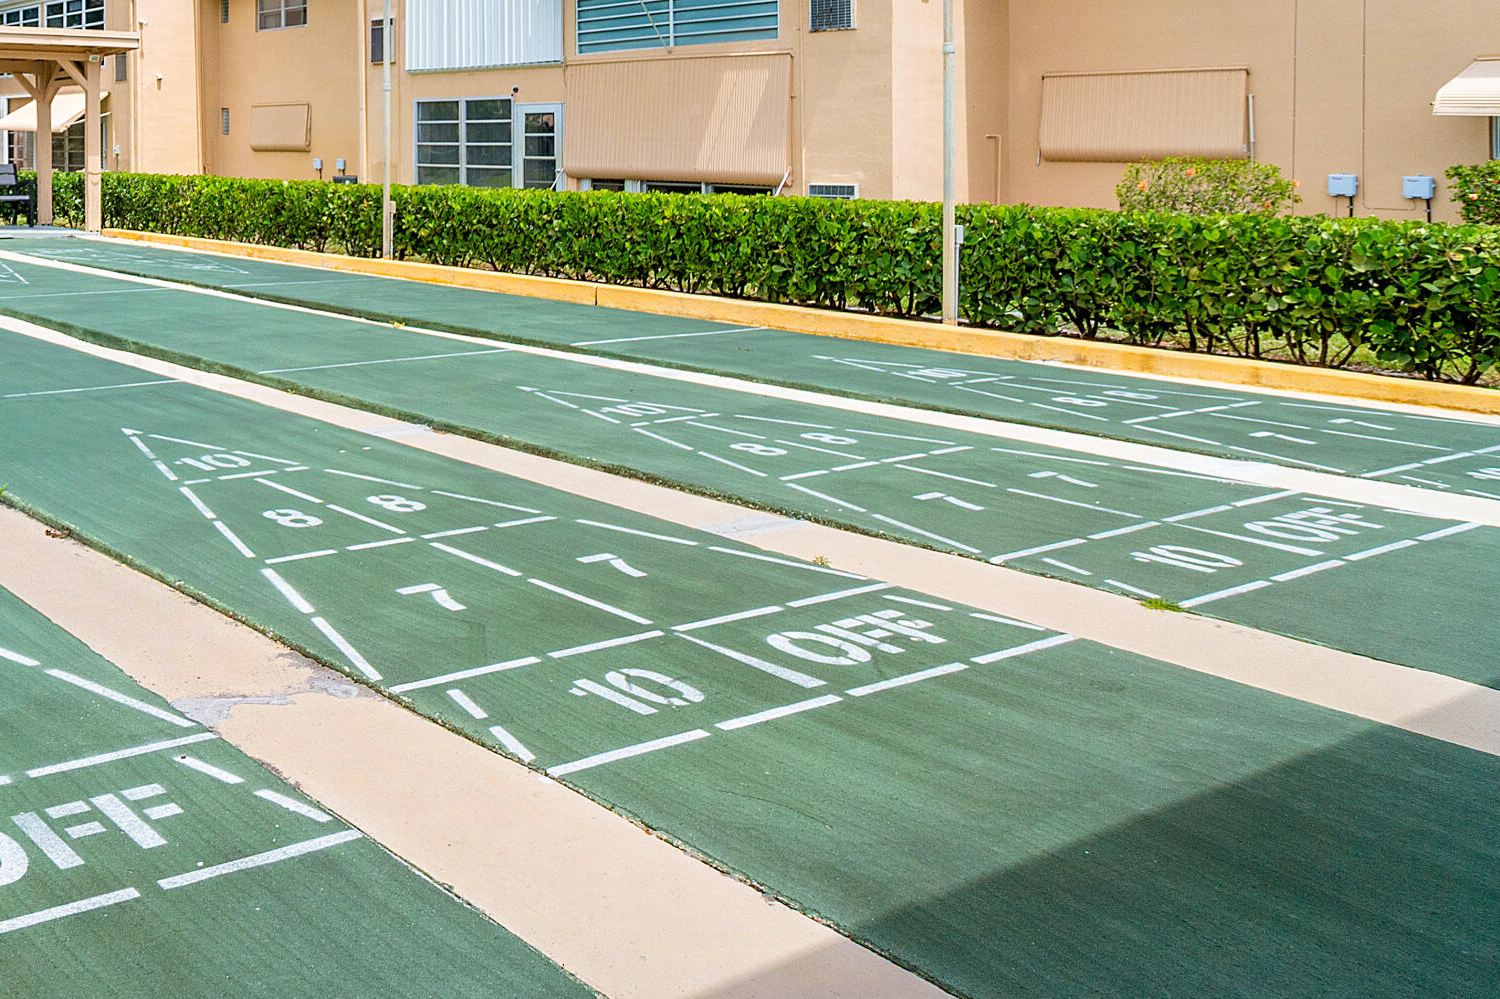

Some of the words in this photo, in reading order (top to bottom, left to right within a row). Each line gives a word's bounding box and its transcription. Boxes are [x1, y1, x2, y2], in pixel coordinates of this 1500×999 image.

[600, 404, 666, 417] 10
[799, 432, 859, 445] 8
[729, 442, 789, 456] 8
[173, 453, 251, 471] 10
[1027, 471, 1099, 488] 7
[365, 495, 427, 513] 8
[913, 492, 985, 511] 7
[262, 509, 324, 528] 8
[1130, 545, 1244, 574] 10
[1243, 507, 1385, 543] OFF
[576, 553, 649, 577] 7
[394, 583, 468, 612] 7
[568, 668, 707, 715] 10
[766, 609, 947, 666] OFF
